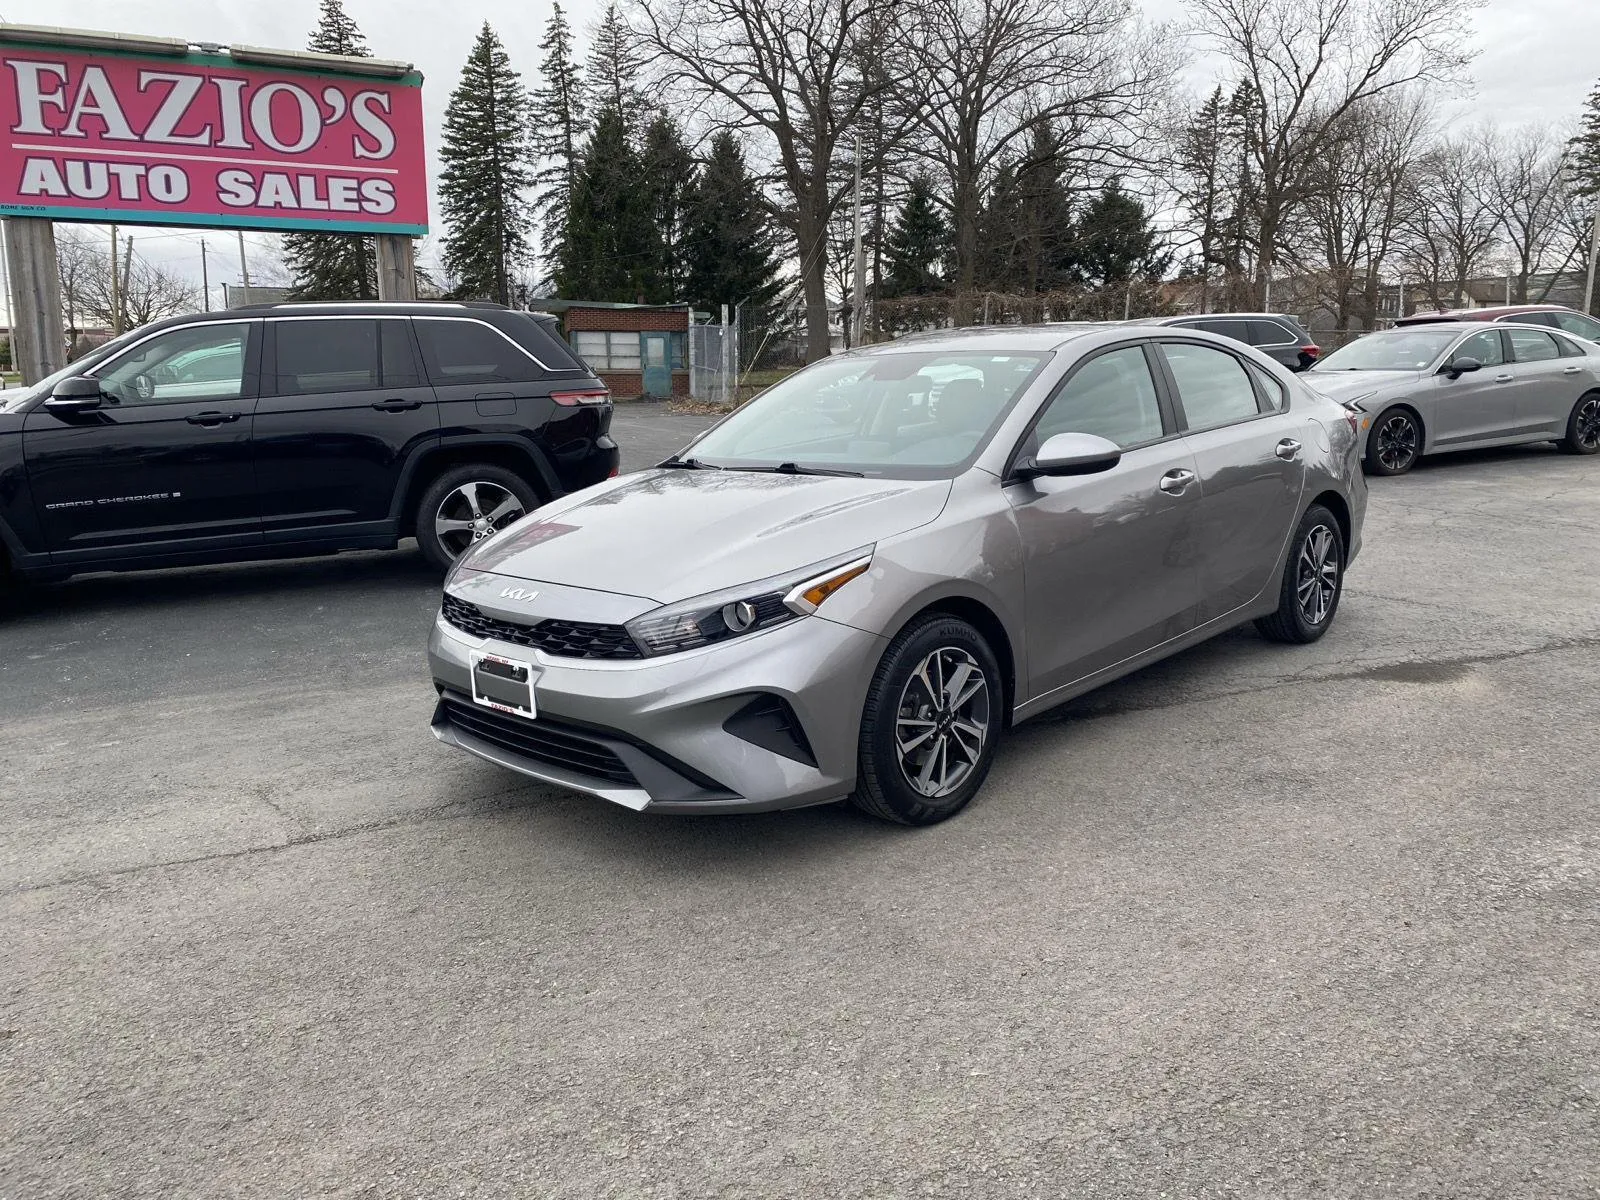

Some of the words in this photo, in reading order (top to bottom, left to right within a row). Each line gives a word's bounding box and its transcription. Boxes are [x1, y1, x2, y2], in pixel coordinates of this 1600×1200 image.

[4, 58, 397, 161] FAZIO'S
[17, 156, 190, 204] AUTO
[216, 169, 397, 215] SALES
[46, 500, 94, 509] GRAND
[97, 493, 169, 504] CHEROKEE
[500, 585, 540, 602] KIA
